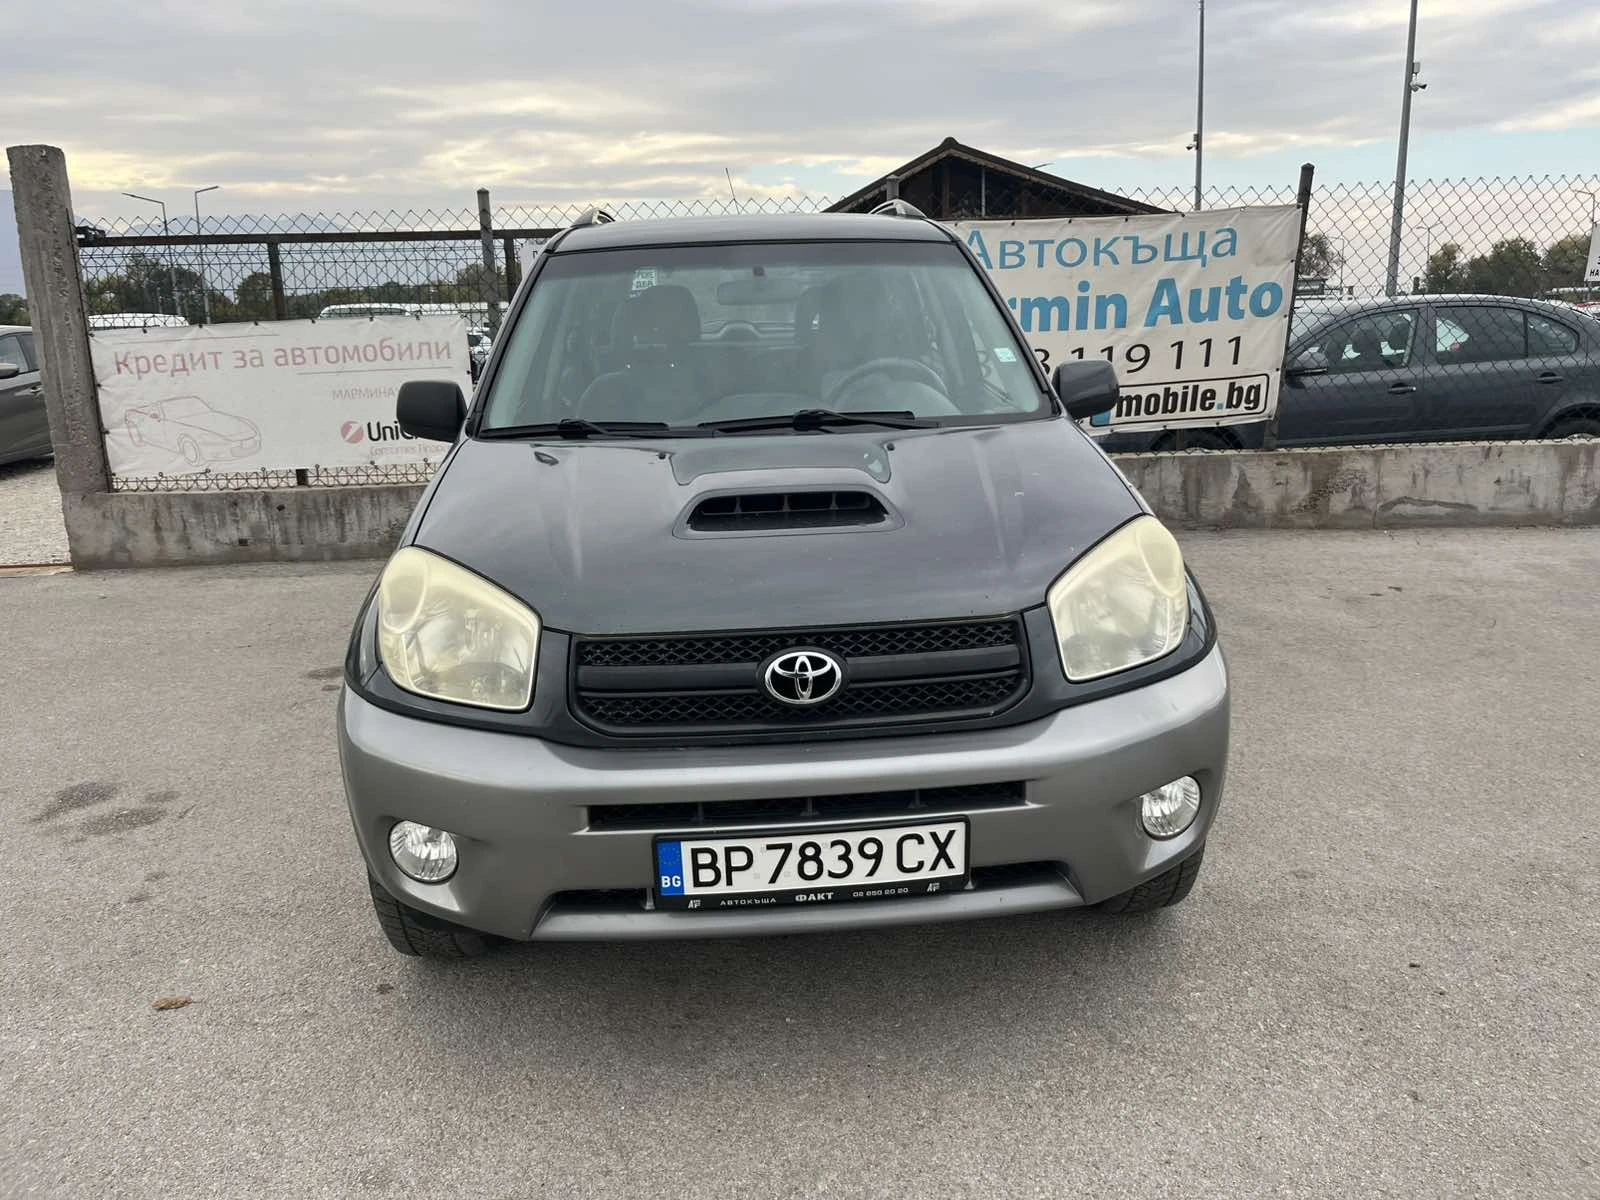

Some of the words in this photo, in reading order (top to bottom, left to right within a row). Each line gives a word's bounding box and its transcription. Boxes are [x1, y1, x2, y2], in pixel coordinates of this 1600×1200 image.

[967, 227, 1238, 269] Автокъща
[1144, 275, 1283, 328] Auto
[114, 351, 222, 377] Кредит
[233, 348, 263, 368] за
[274, 339, 452, 368] автомобили
[1170, 335, 1243, 370] 111
[1115, 382, 1262, 418] mobile.bg
[690, 846, 754, 888] BP
[765, 836, 884, 885] 7839
[896, 829, 957, 873] CX
[661, 877, 681, 888] BG
[795, 892, 834, 902] ФАКТ
